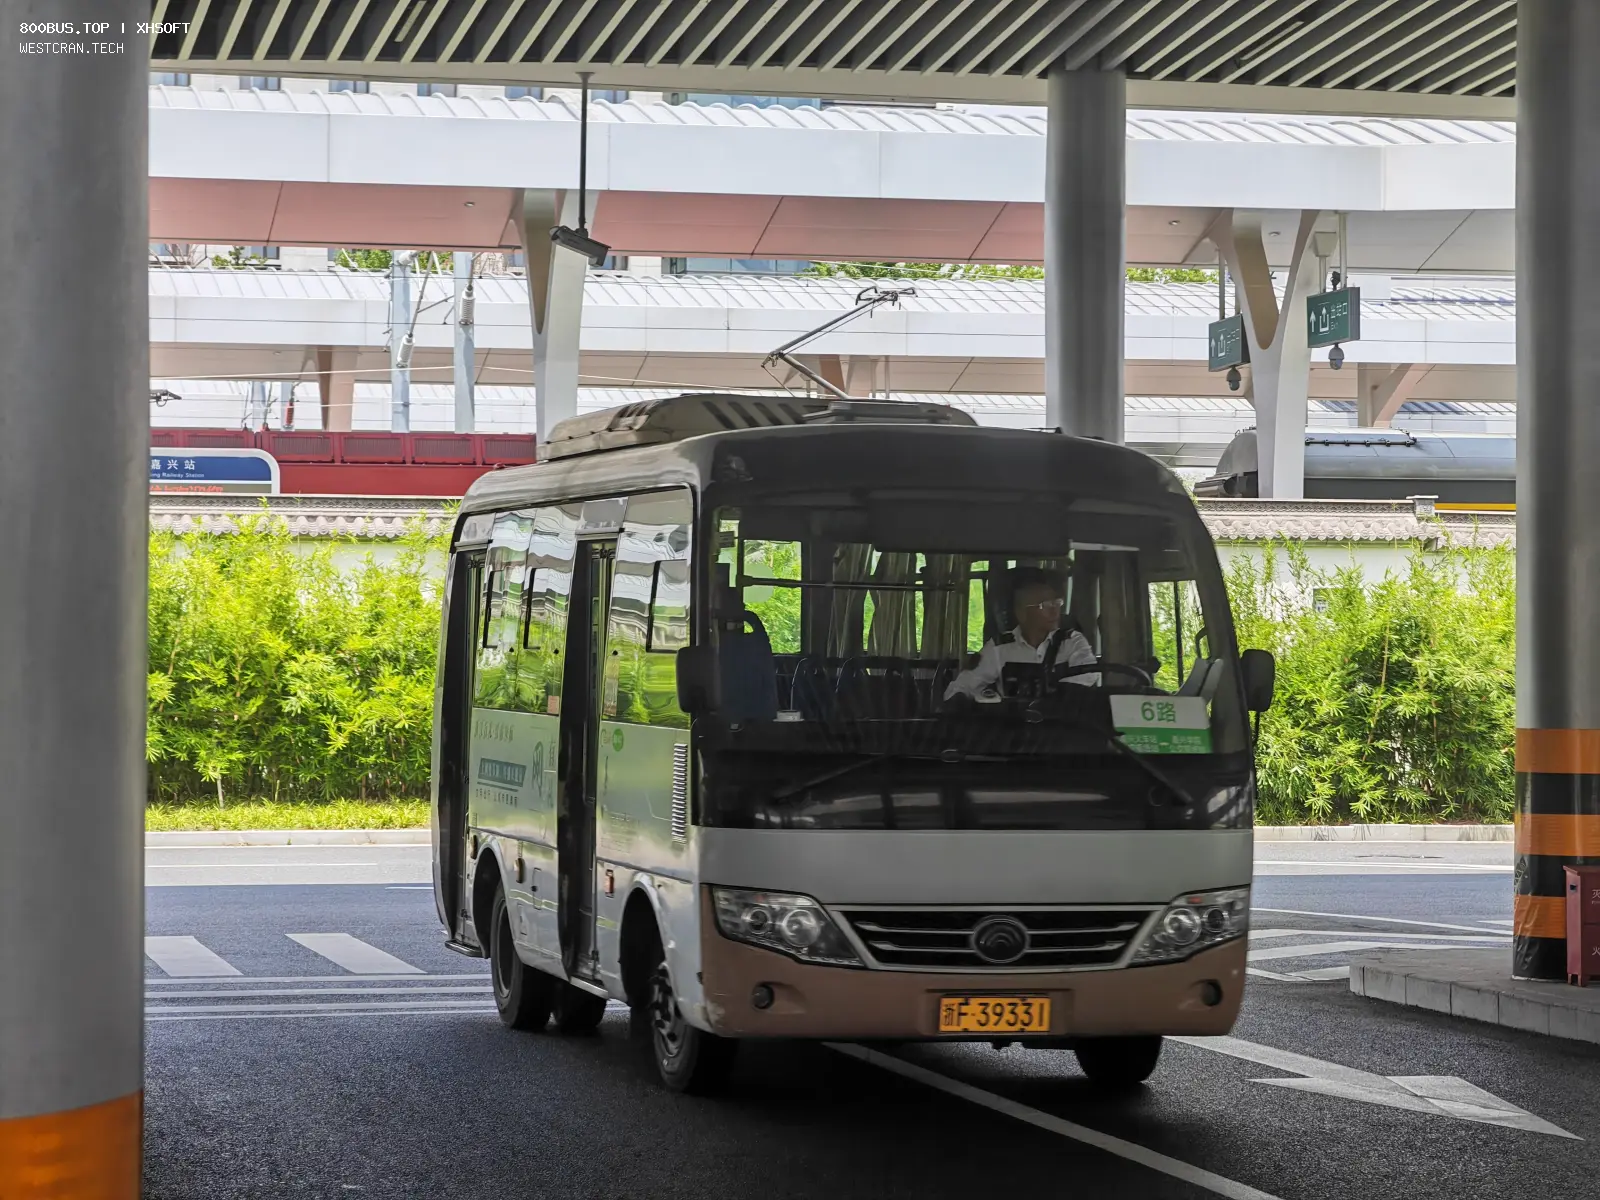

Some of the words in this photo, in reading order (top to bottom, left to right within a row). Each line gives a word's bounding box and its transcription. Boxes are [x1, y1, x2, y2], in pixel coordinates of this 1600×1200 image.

[151, 459, 196, 470] 嘉兴站
[1141, 701, 1176, 723] 6路
